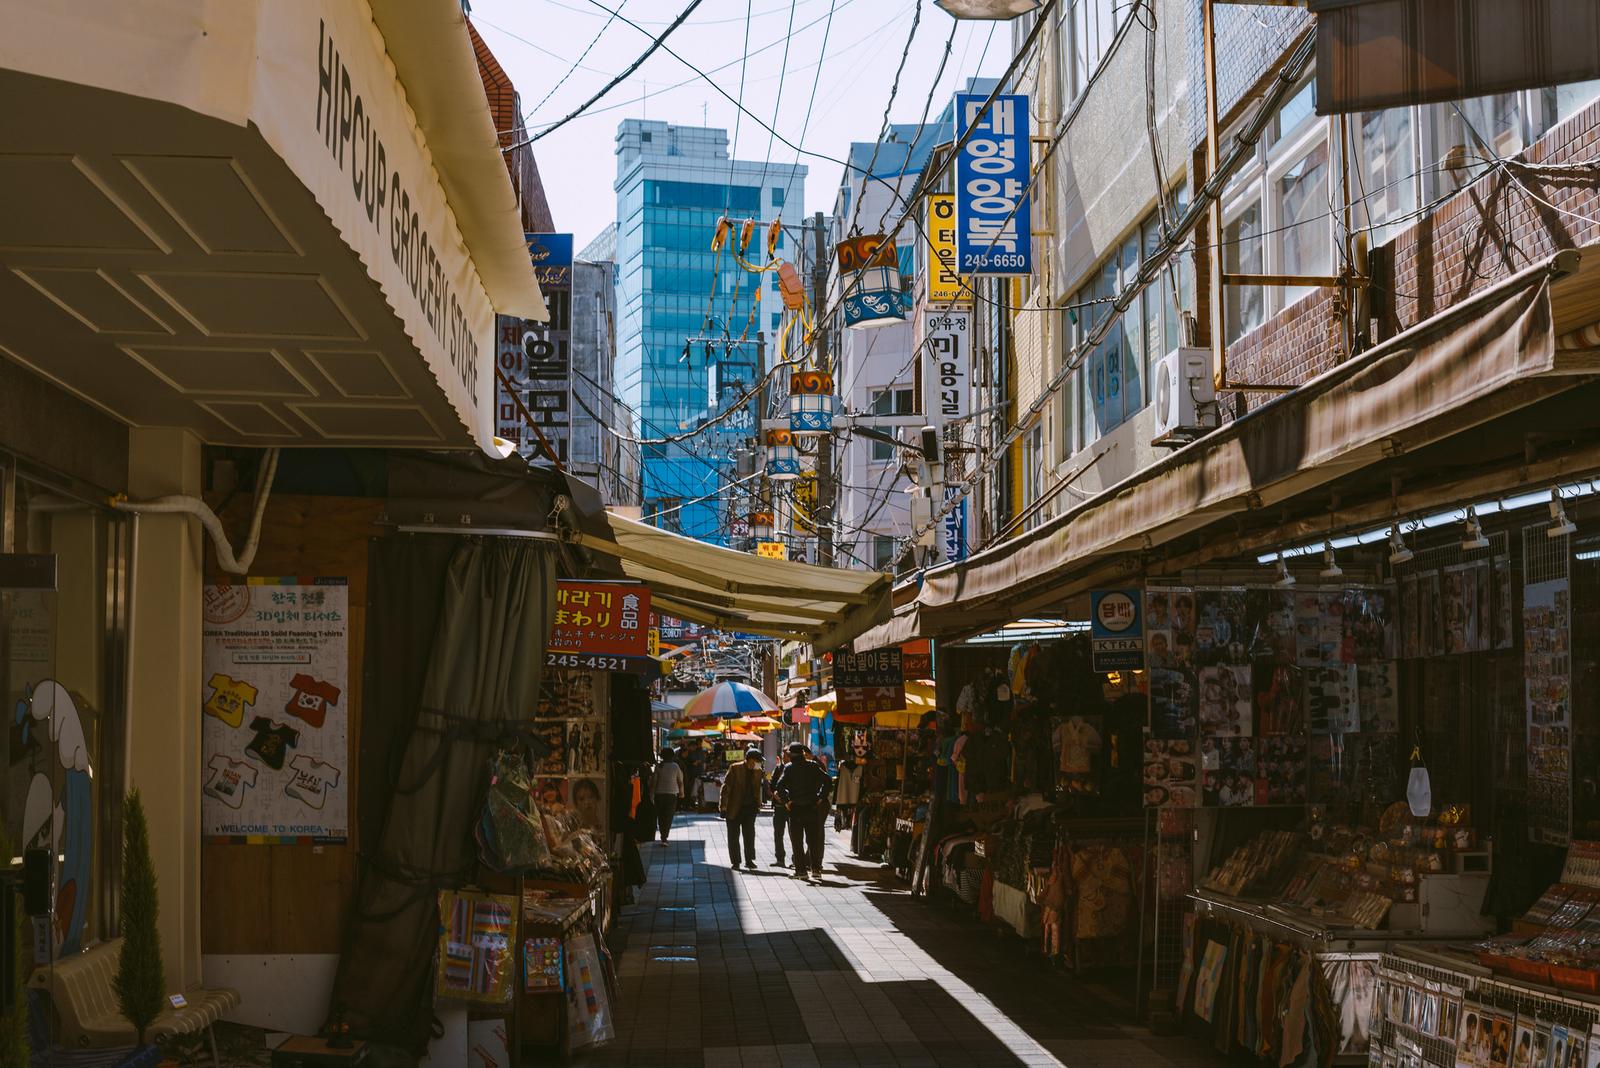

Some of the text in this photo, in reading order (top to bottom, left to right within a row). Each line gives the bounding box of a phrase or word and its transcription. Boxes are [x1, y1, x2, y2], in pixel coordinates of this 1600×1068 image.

[966, 100, 1022, 253] 대영양복
[316, 18, 479, 409] HIPCUP GROCERY STORE
[965, 254, 1025, 267] 245-6650
[933, 290, 970, 298] 246-070
[933, 334, 964, 415] 미용실
[271, 591, 297, 605] 한국
[620, 593, 640, 629] 食品
[1102, 602, 1131, 618] 담배
[547, 654, 627, 671] 245-4521
[220, 824, 269, 834] WELCOME
[272, 824, 286, 834] TO
[289, 823, 324, 834] KOREA
